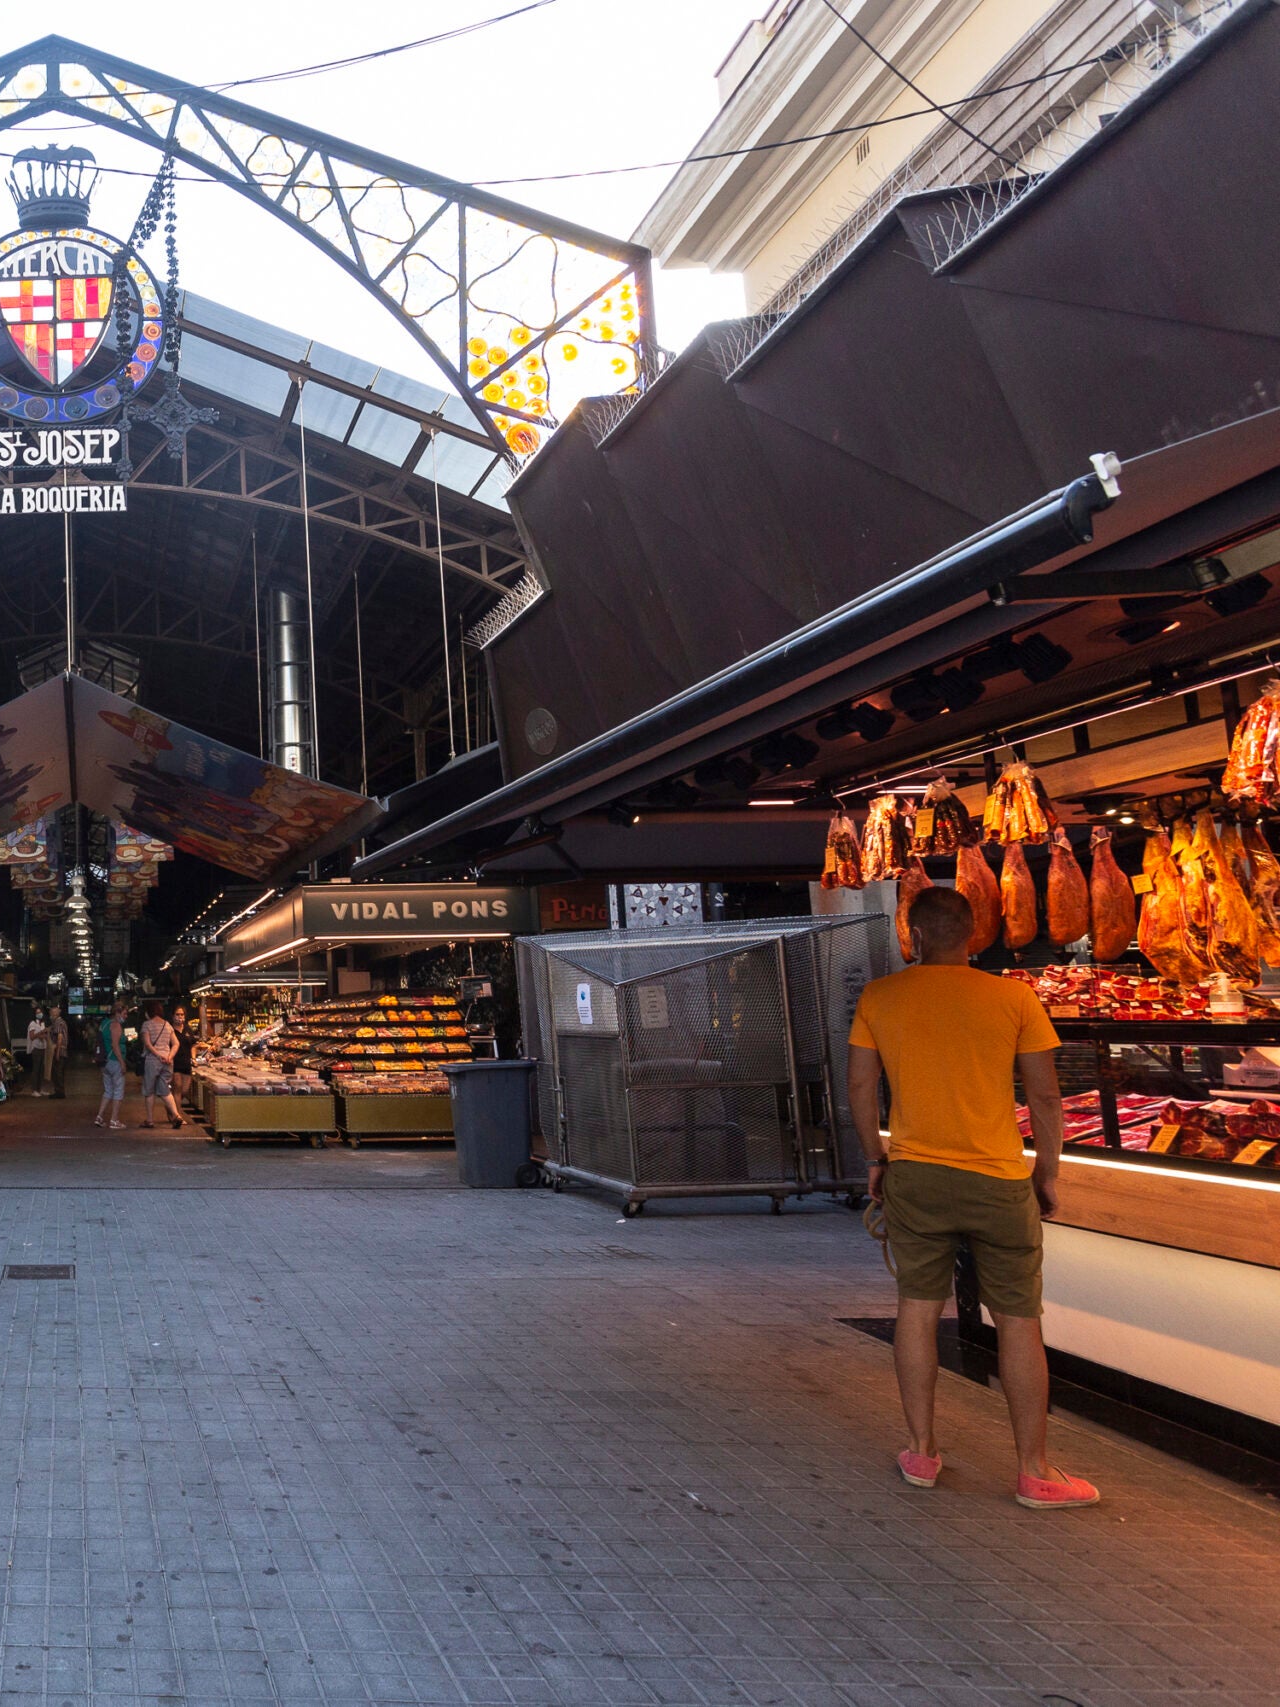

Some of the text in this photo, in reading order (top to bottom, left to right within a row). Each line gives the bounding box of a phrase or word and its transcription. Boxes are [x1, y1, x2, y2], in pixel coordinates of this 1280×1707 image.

[22, 429, 120, 465] JOSEP
[21, 485, 127, 514] BOQUERIA
[331, 900, 509, 920] VIDAL PONS
